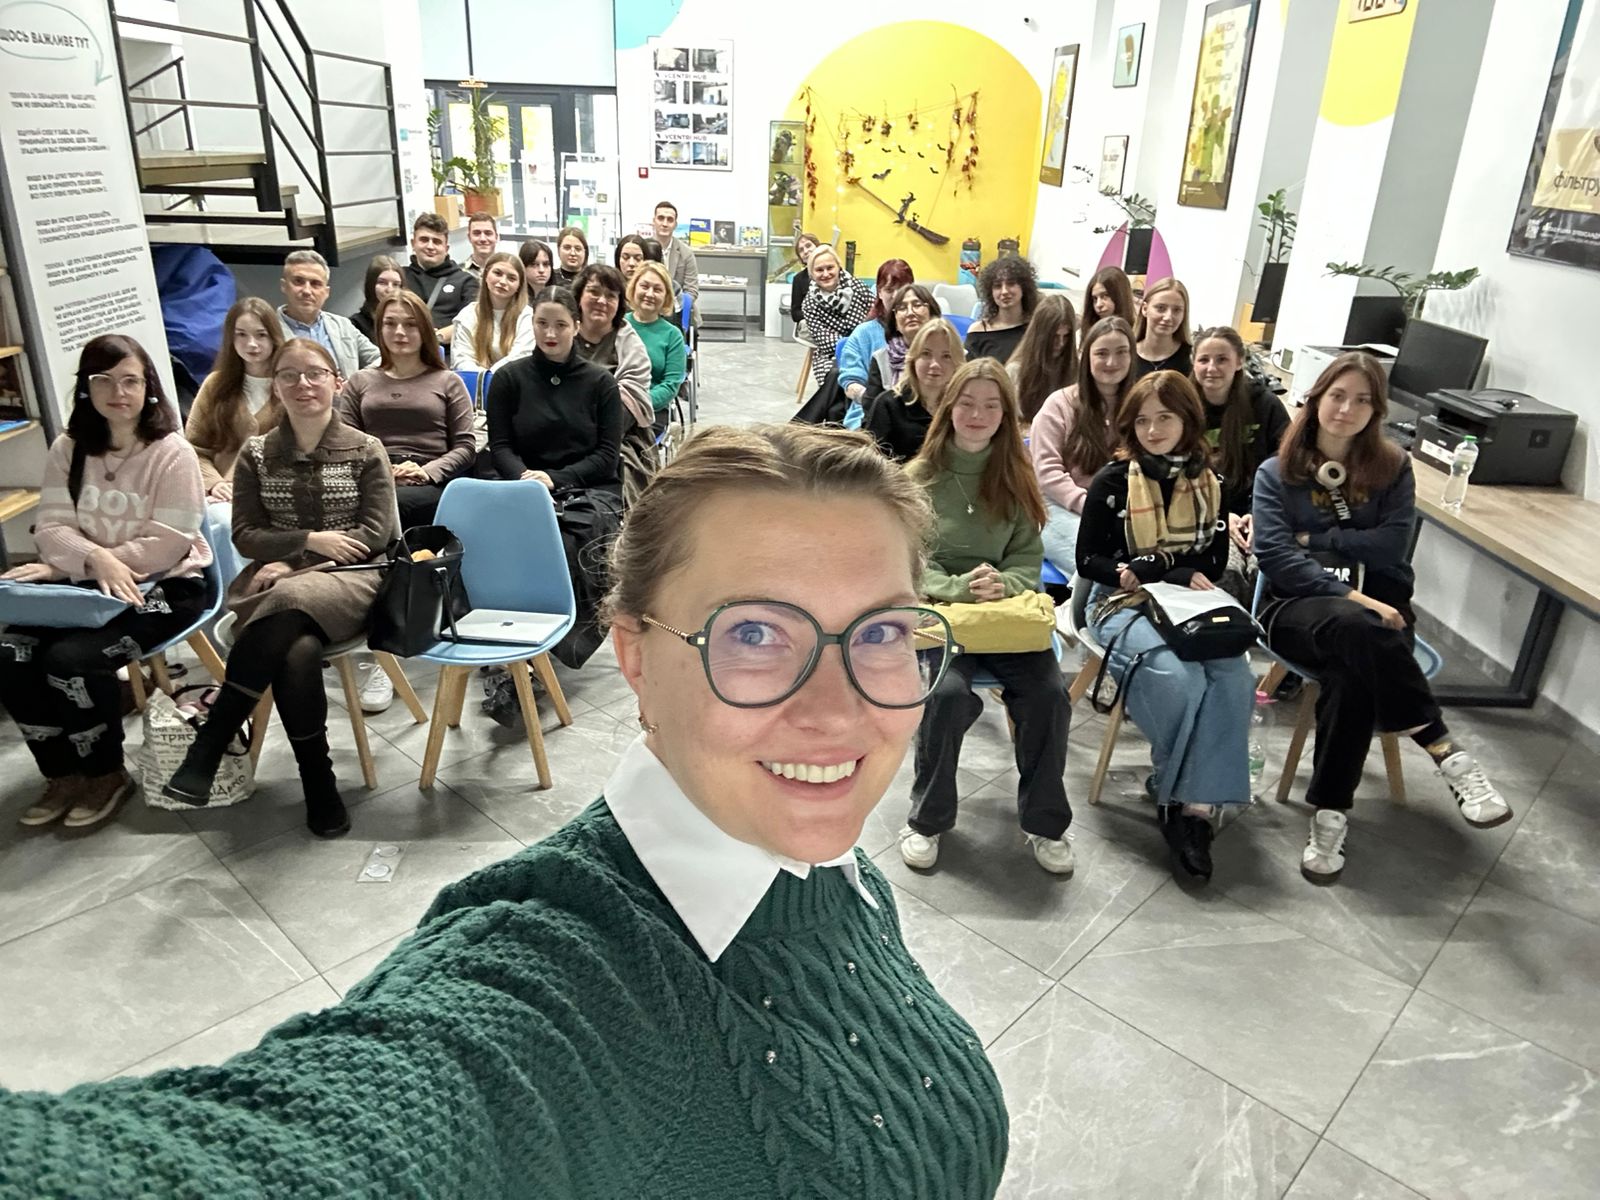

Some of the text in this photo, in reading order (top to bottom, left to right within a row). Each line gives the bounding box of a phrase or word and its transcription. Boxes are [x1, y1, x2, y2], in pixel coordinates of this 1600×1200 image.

[31, 32, 74, 48] ВАЖЛИВЕ
[74, 36, 90, 49] ТУТ
[78, 484, 149, 519] BOY
